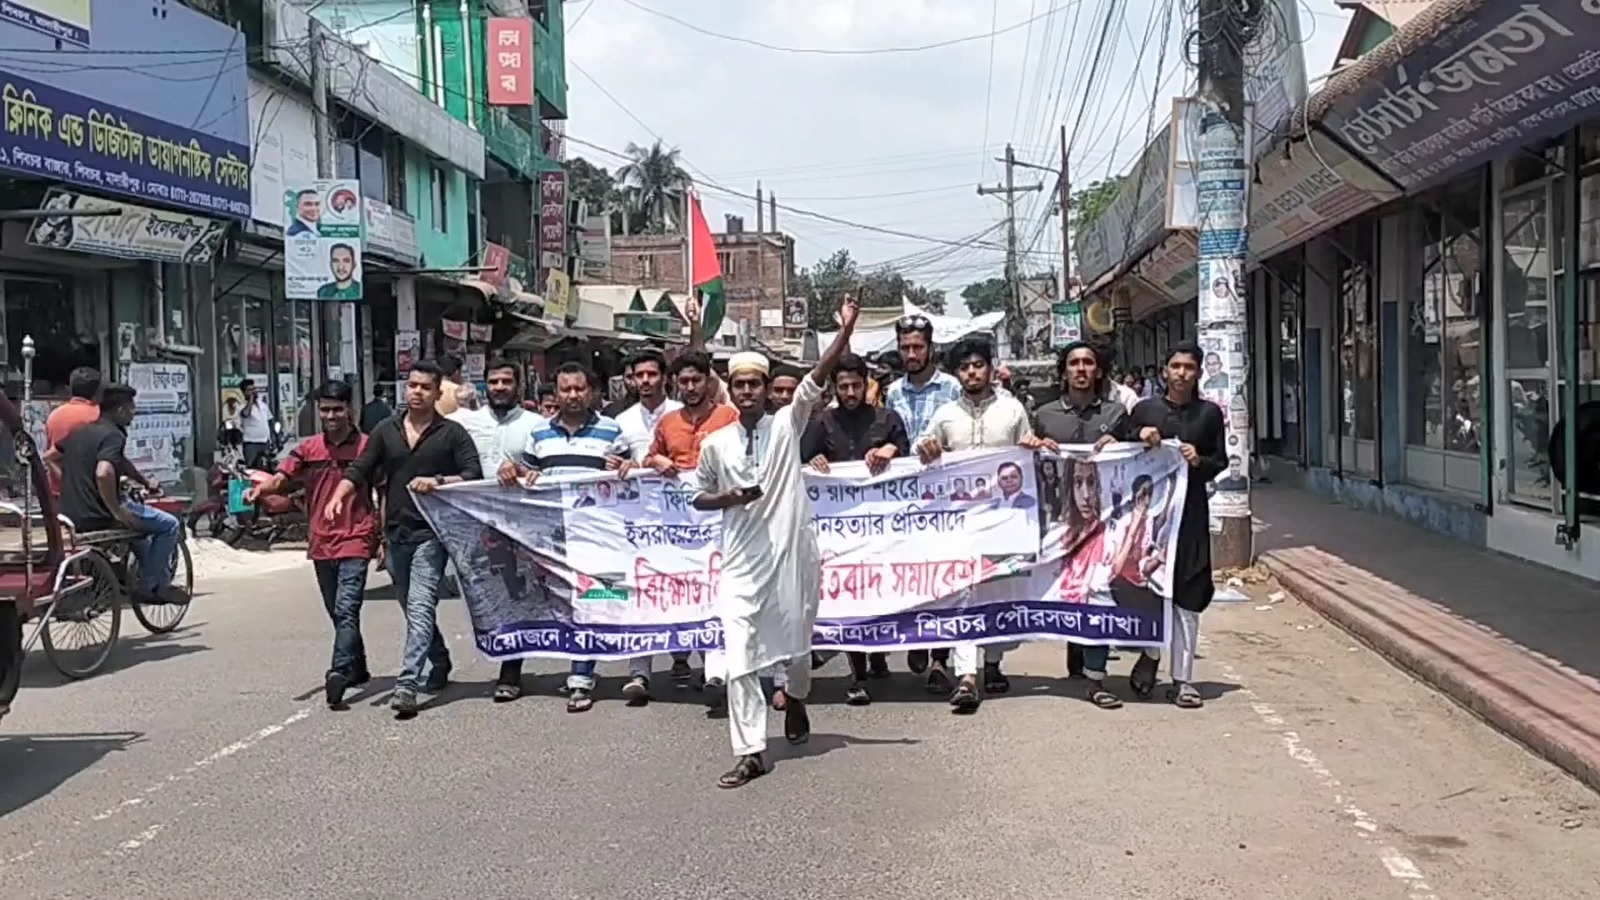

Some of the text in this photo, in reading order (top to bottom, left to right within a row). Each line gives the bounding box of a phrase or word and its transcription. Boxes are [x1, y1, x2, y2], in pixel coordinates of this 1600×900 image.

[1430, 4, 1574, 92] জনতা
[2, 83, 53, 141] ক্লিনিক
[58, 113, 85, 149] এন্ড
[87, 108, 144, 165] ডিজিটাল
[214, 150, 249, 190] সেন্টার
[891, 503, 967, 535] প্রতিবাদে
[820, 549, 884, 600] তিবাদ
[890, 557, 978, 601] সমাবেশ
[573, 629, 671, 652] বাংলাদেশ
[915, 611, 987, 640] শিবচর
[996, 603, 1082, 632] পৌরসভা
[1087, 609, 1142, 636] শাখা
